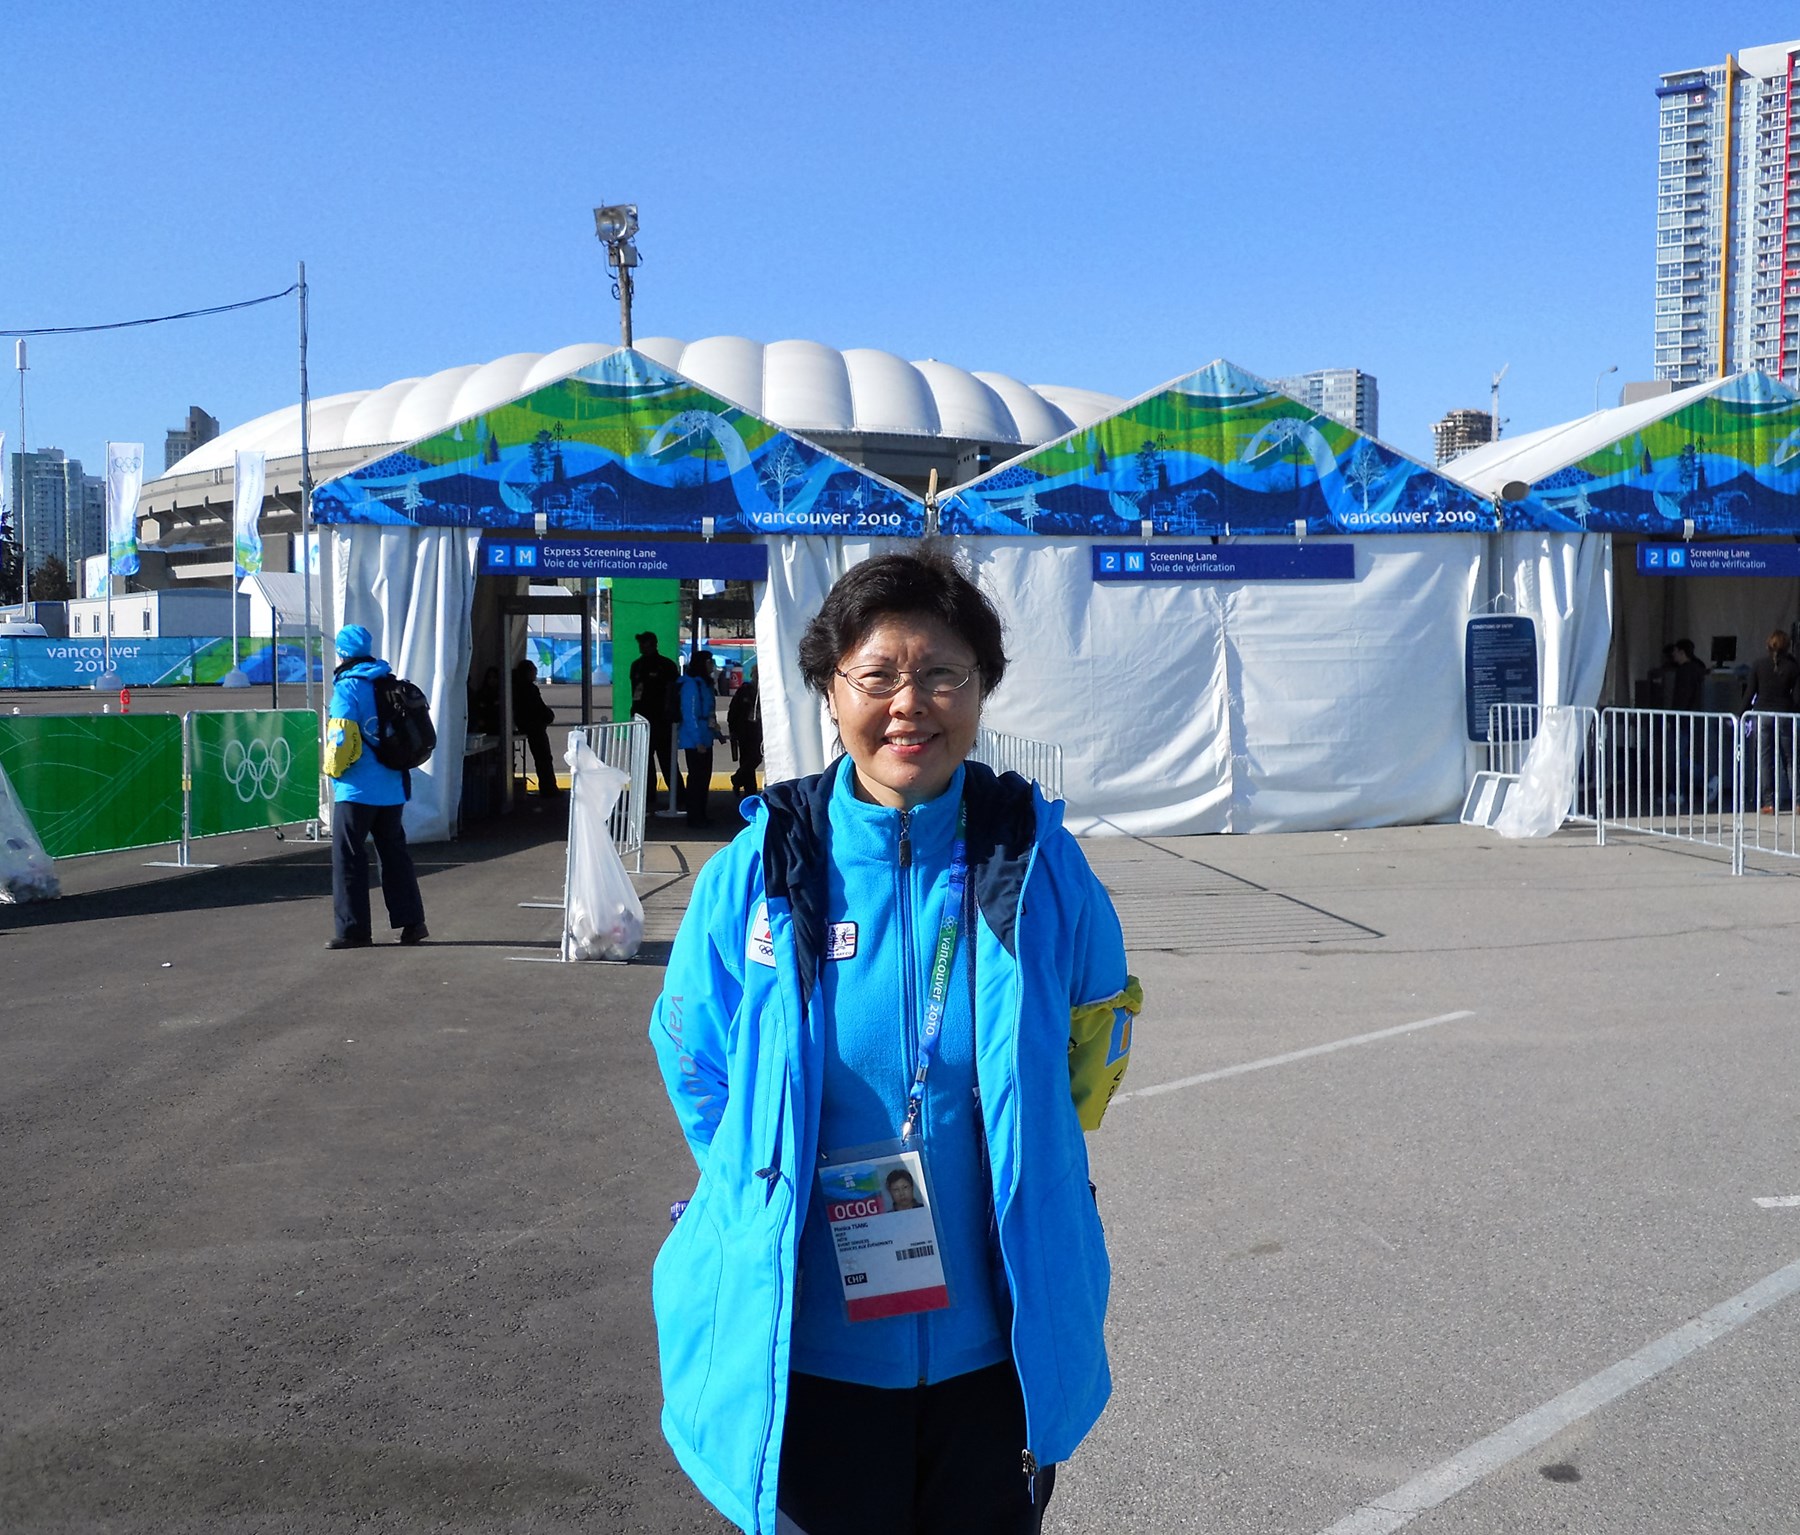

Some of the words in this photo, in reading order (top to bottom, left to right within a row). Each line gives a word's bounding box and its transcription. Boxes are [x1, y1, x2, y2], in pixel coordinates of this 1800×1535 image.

[752, 511, 851, 525] vancouver
[857, 512, 902, 526] 2010
[1340, 510, 1430, 524] vancouver
[1435, 510, 1477, 524] 2010
[494, 549, 504, 563] 2
[519, 550, 532, 564] M
[543, 546, 582, 558] Express
[583, 547, 632, 559] Screening
[633, 548, 658, 558] Lane
[1150, 551, 1194, 563] Screening
[1195, 552, 1218, 561] Lane
[1650, 551, 1659, 565] 2
[1690, 548, 1729, 559] Screening
[1731, 549, 1750, 558] Lane
[543, 558, 566, 569] Voie
[567, 558, 580, 569] de
[582, 557, 636, 570] vérification
[638, 559, 668, 571] rapide
[1105, 556, 1115, 569] 2
[1128, 556, 1140, 569] N
[1150, 563, 1171, 573] Voie
[1172, 563, 1184, 572] de
[1186, 562, 1236, 573] vérification
[1690, 560, 1708, 569] Voie
[1709, 559, 1720, 569] de
[1722, 559, 1766, 569] vérification
[932, 936, 951, 1002] vancouver
[925, 1003, 940, 1036] 2010
[834, 1199, 878, 1220] OCOG
[847, 1275, 866, 1285] CHP
